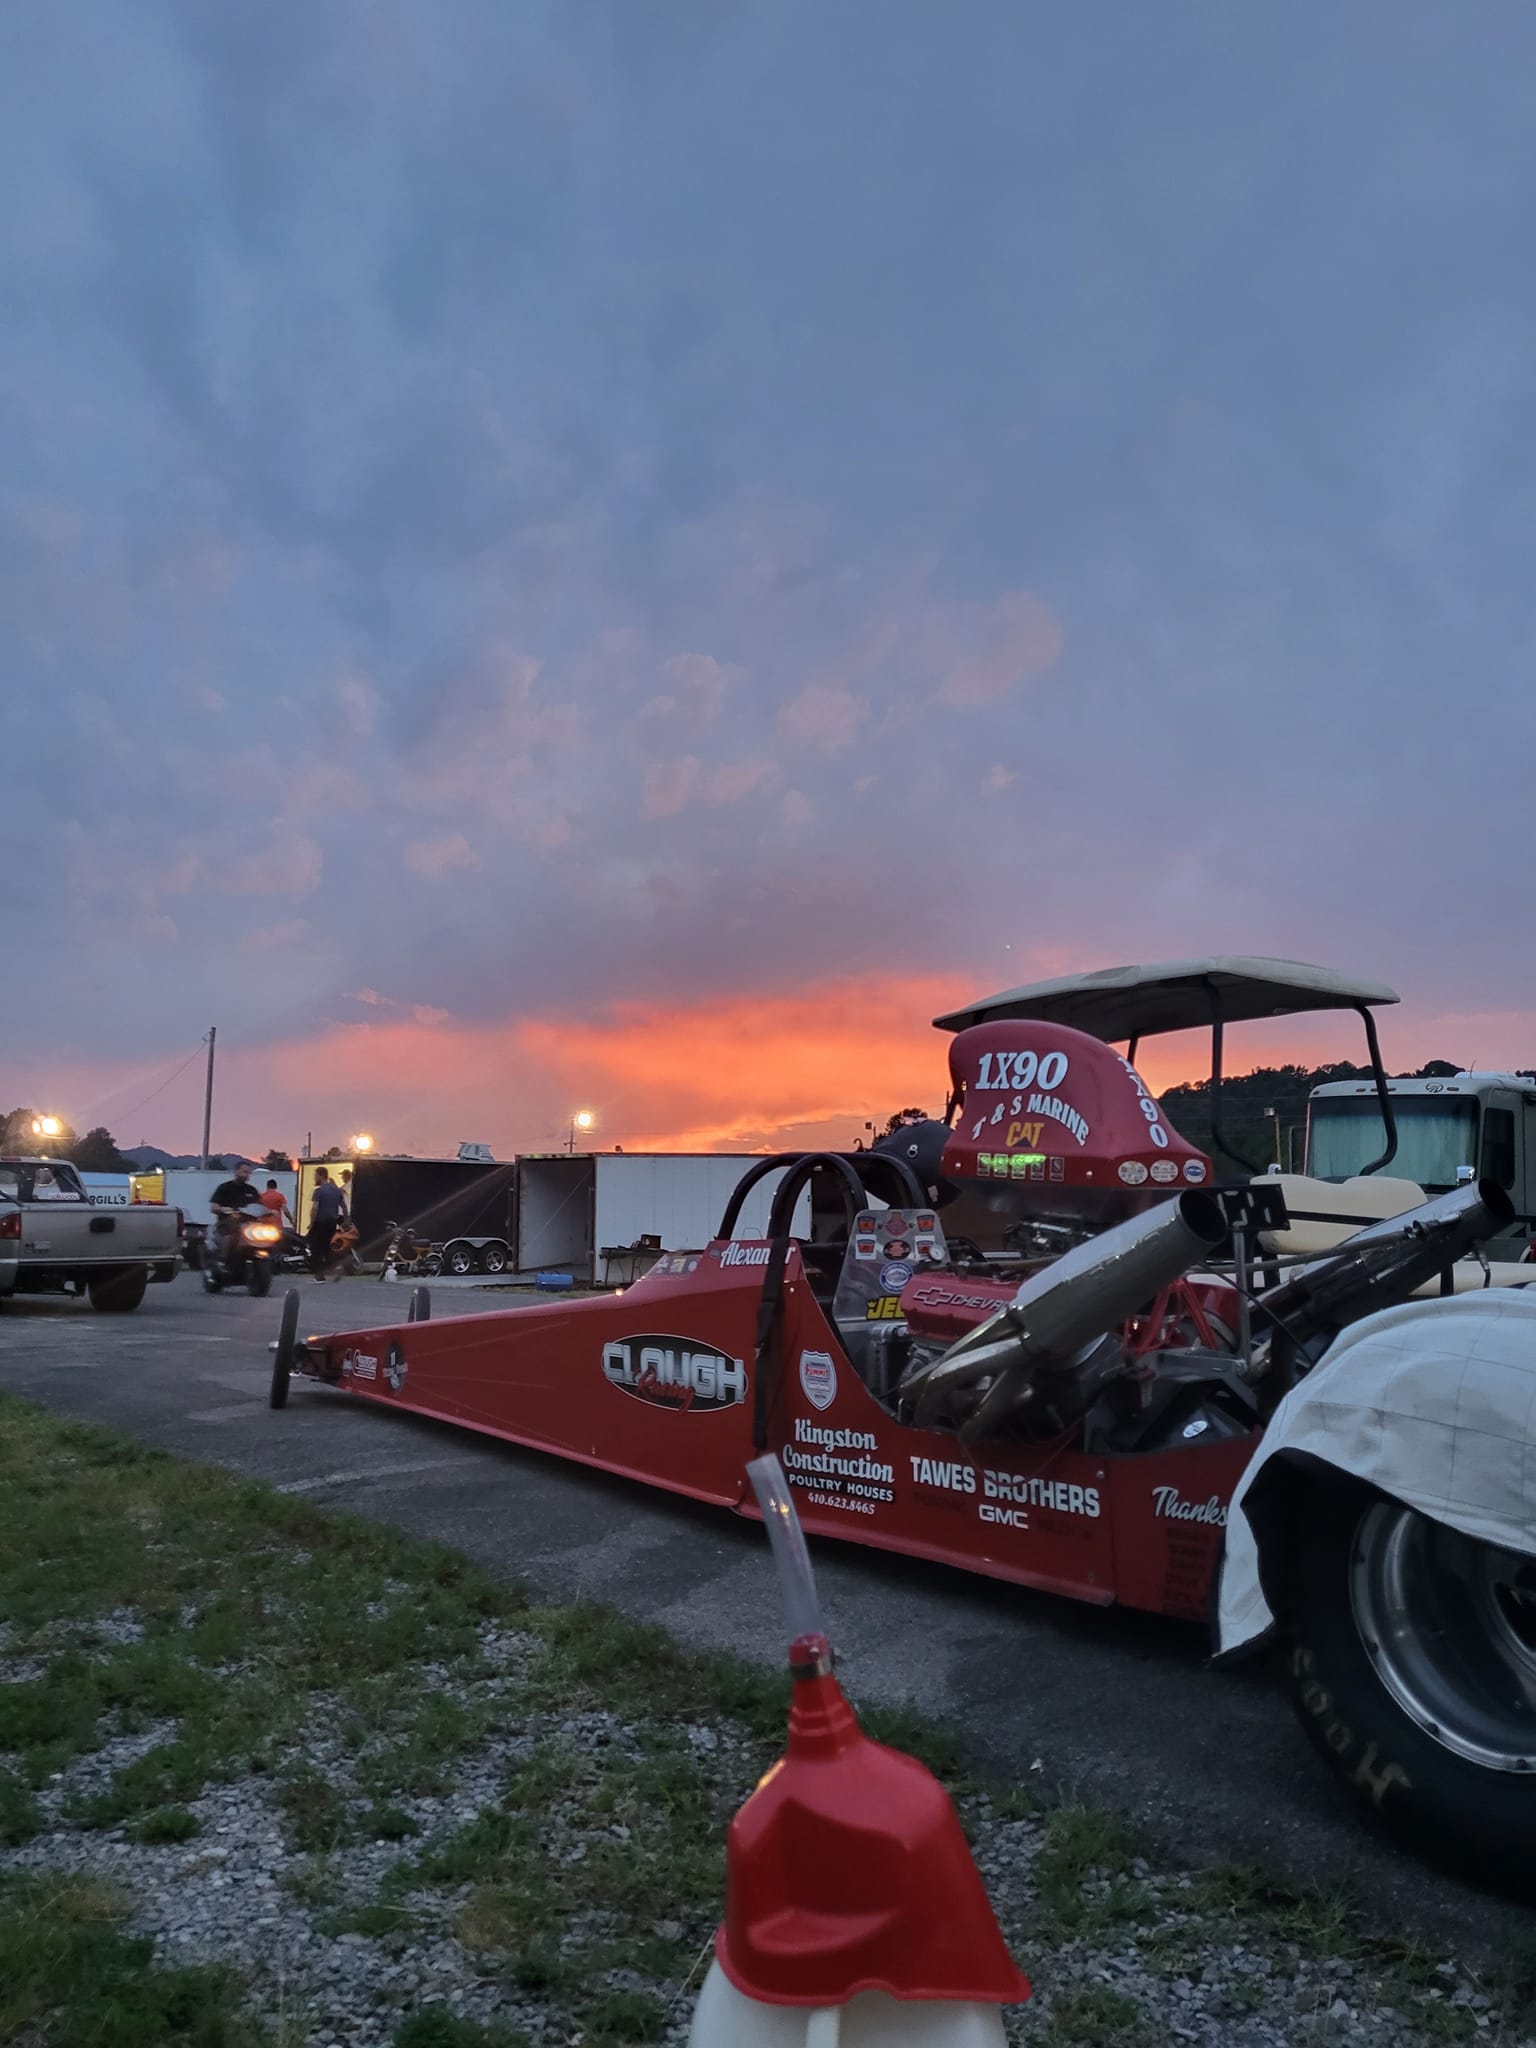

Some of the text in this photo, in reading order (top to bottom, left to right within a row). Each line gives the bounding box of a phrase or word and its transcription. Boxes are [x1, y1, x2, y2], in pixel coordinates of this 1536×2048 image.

[975, 1051, 1069, 1090] 1X90
[972, 1094, 1090, 1146] T & S MARINE
[1006, 1121, 1045, 1148] CAT
[603, 1342, 745, 1405] CLOUGH
[794, 1418, 878, 1452] Kingston
[782, 1443, 896, 1484] Construction
[789, 1474, 894, 1502] POULTRY HOUSES
[808, 1492, 876, 1515] 410.623.8465
[910, 1456, 976, 1494] TAWES
[983, 1469, 1101, 1519] BROTHERS
[1152, 1486, 1228, 1527] Thanks
[979, 1504, 1030, 1530] GMC
